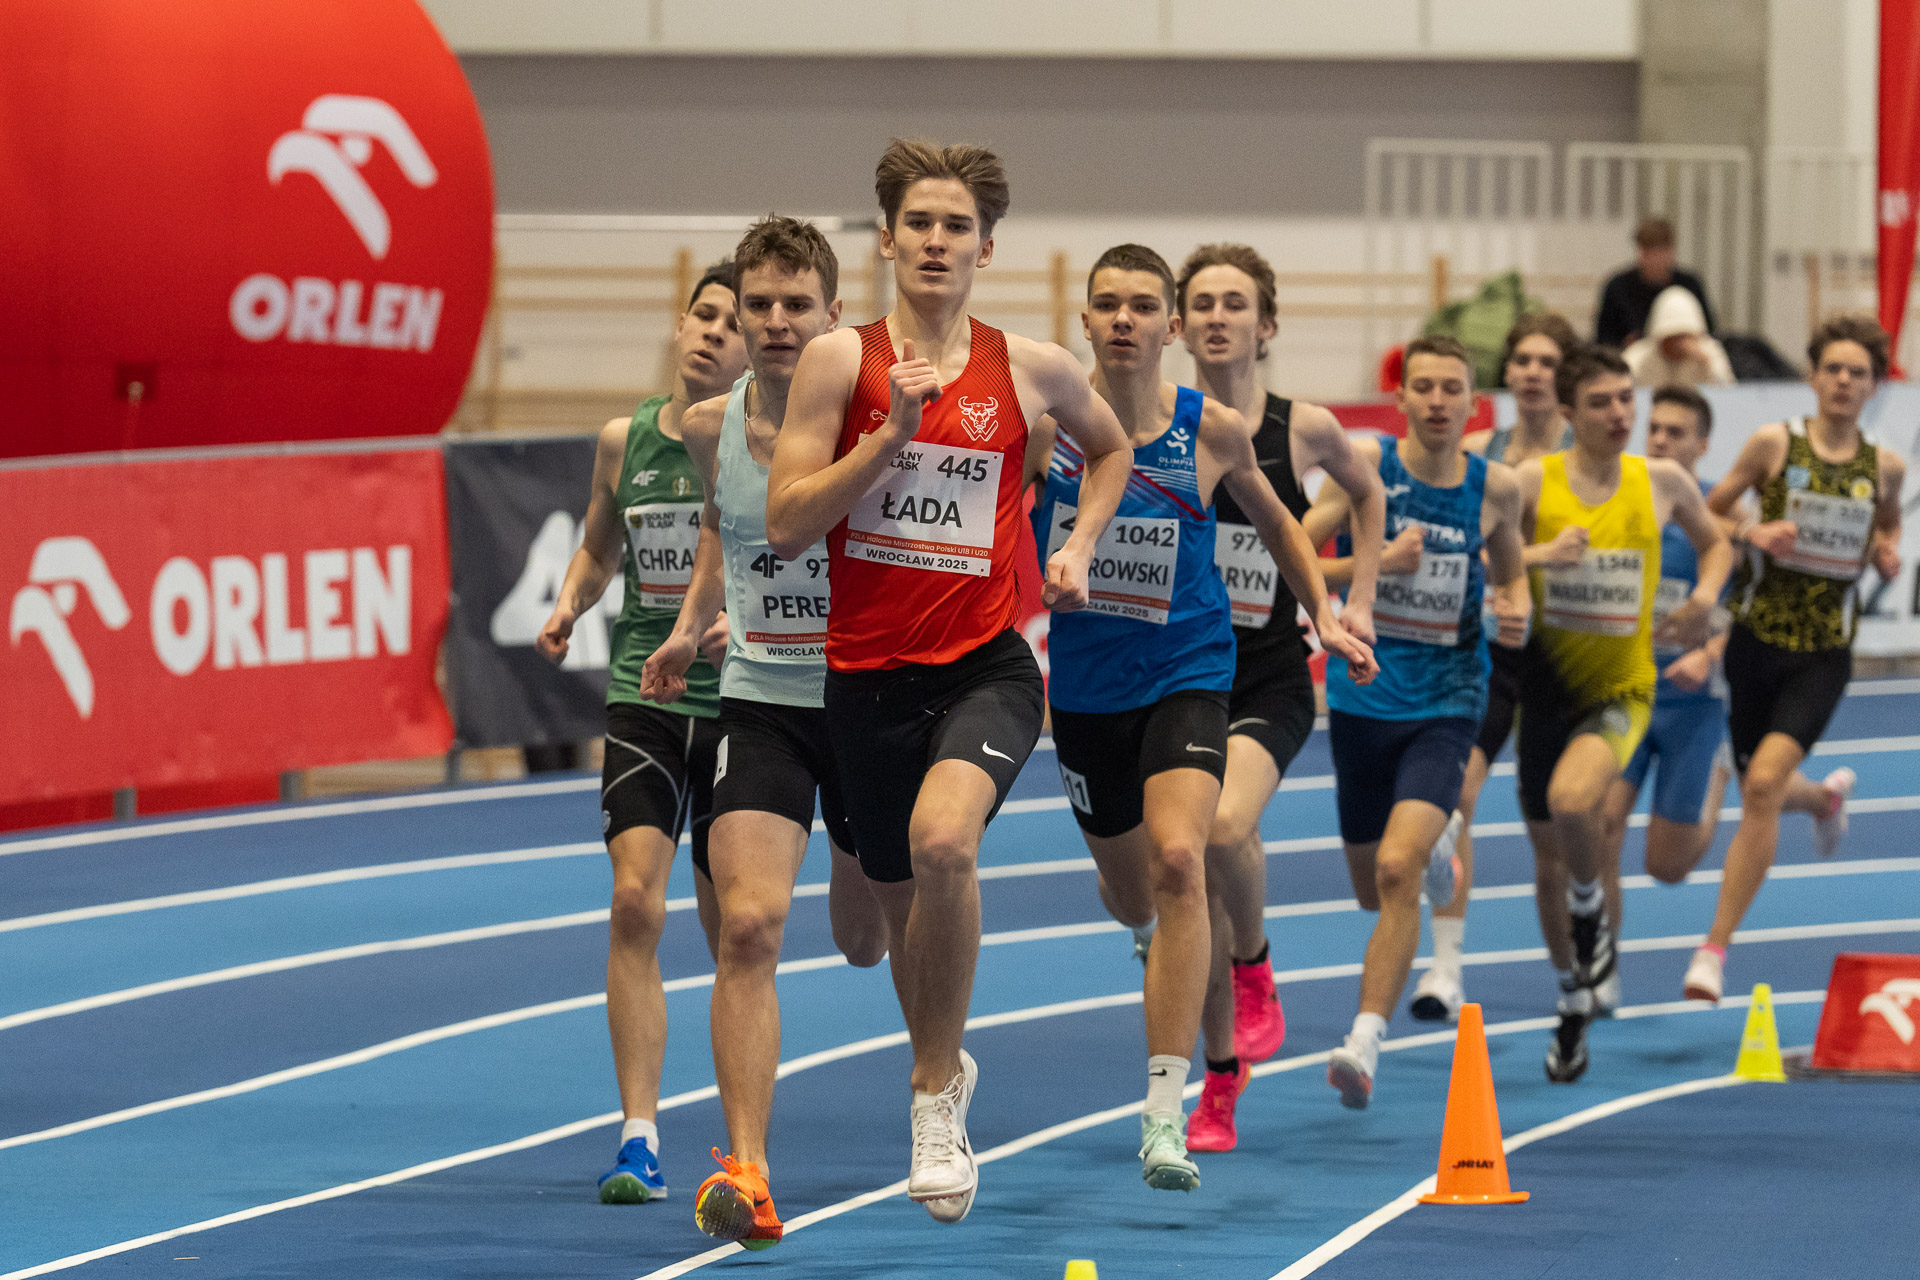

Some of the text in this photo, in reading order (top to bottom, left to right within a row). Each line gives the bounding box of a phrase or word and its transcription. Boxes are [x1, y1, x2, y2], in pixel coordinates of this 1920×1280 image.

[229, 272, 443, 353] ORLEN
[889, 460, 920, 472] LĄSK
[937, 455, 988, 482] 445
[631, 469, 659, 487] 4F
[880, 491, 963, 529] ŁADA
[850, 532, 866, 540] PZLA
[866, 533, 892, 545] Halowe
[893, 540, 935, 551] Mistrzostwa
[936, 544, 957, 553] Polski
[958, 547, 970, 555] U18
[1115, 524, 1175, 547] 1042
[750, 552, 784, 579] 4F
[866, 547, 968, 570] WROCŁAW 2025
[1224, 565, 1271, 592] RYN
[150, 545, 411, 677] ORLEN
[762, 595, 830, 618] PERE
[1122, 606, 1149, 618] 2025
